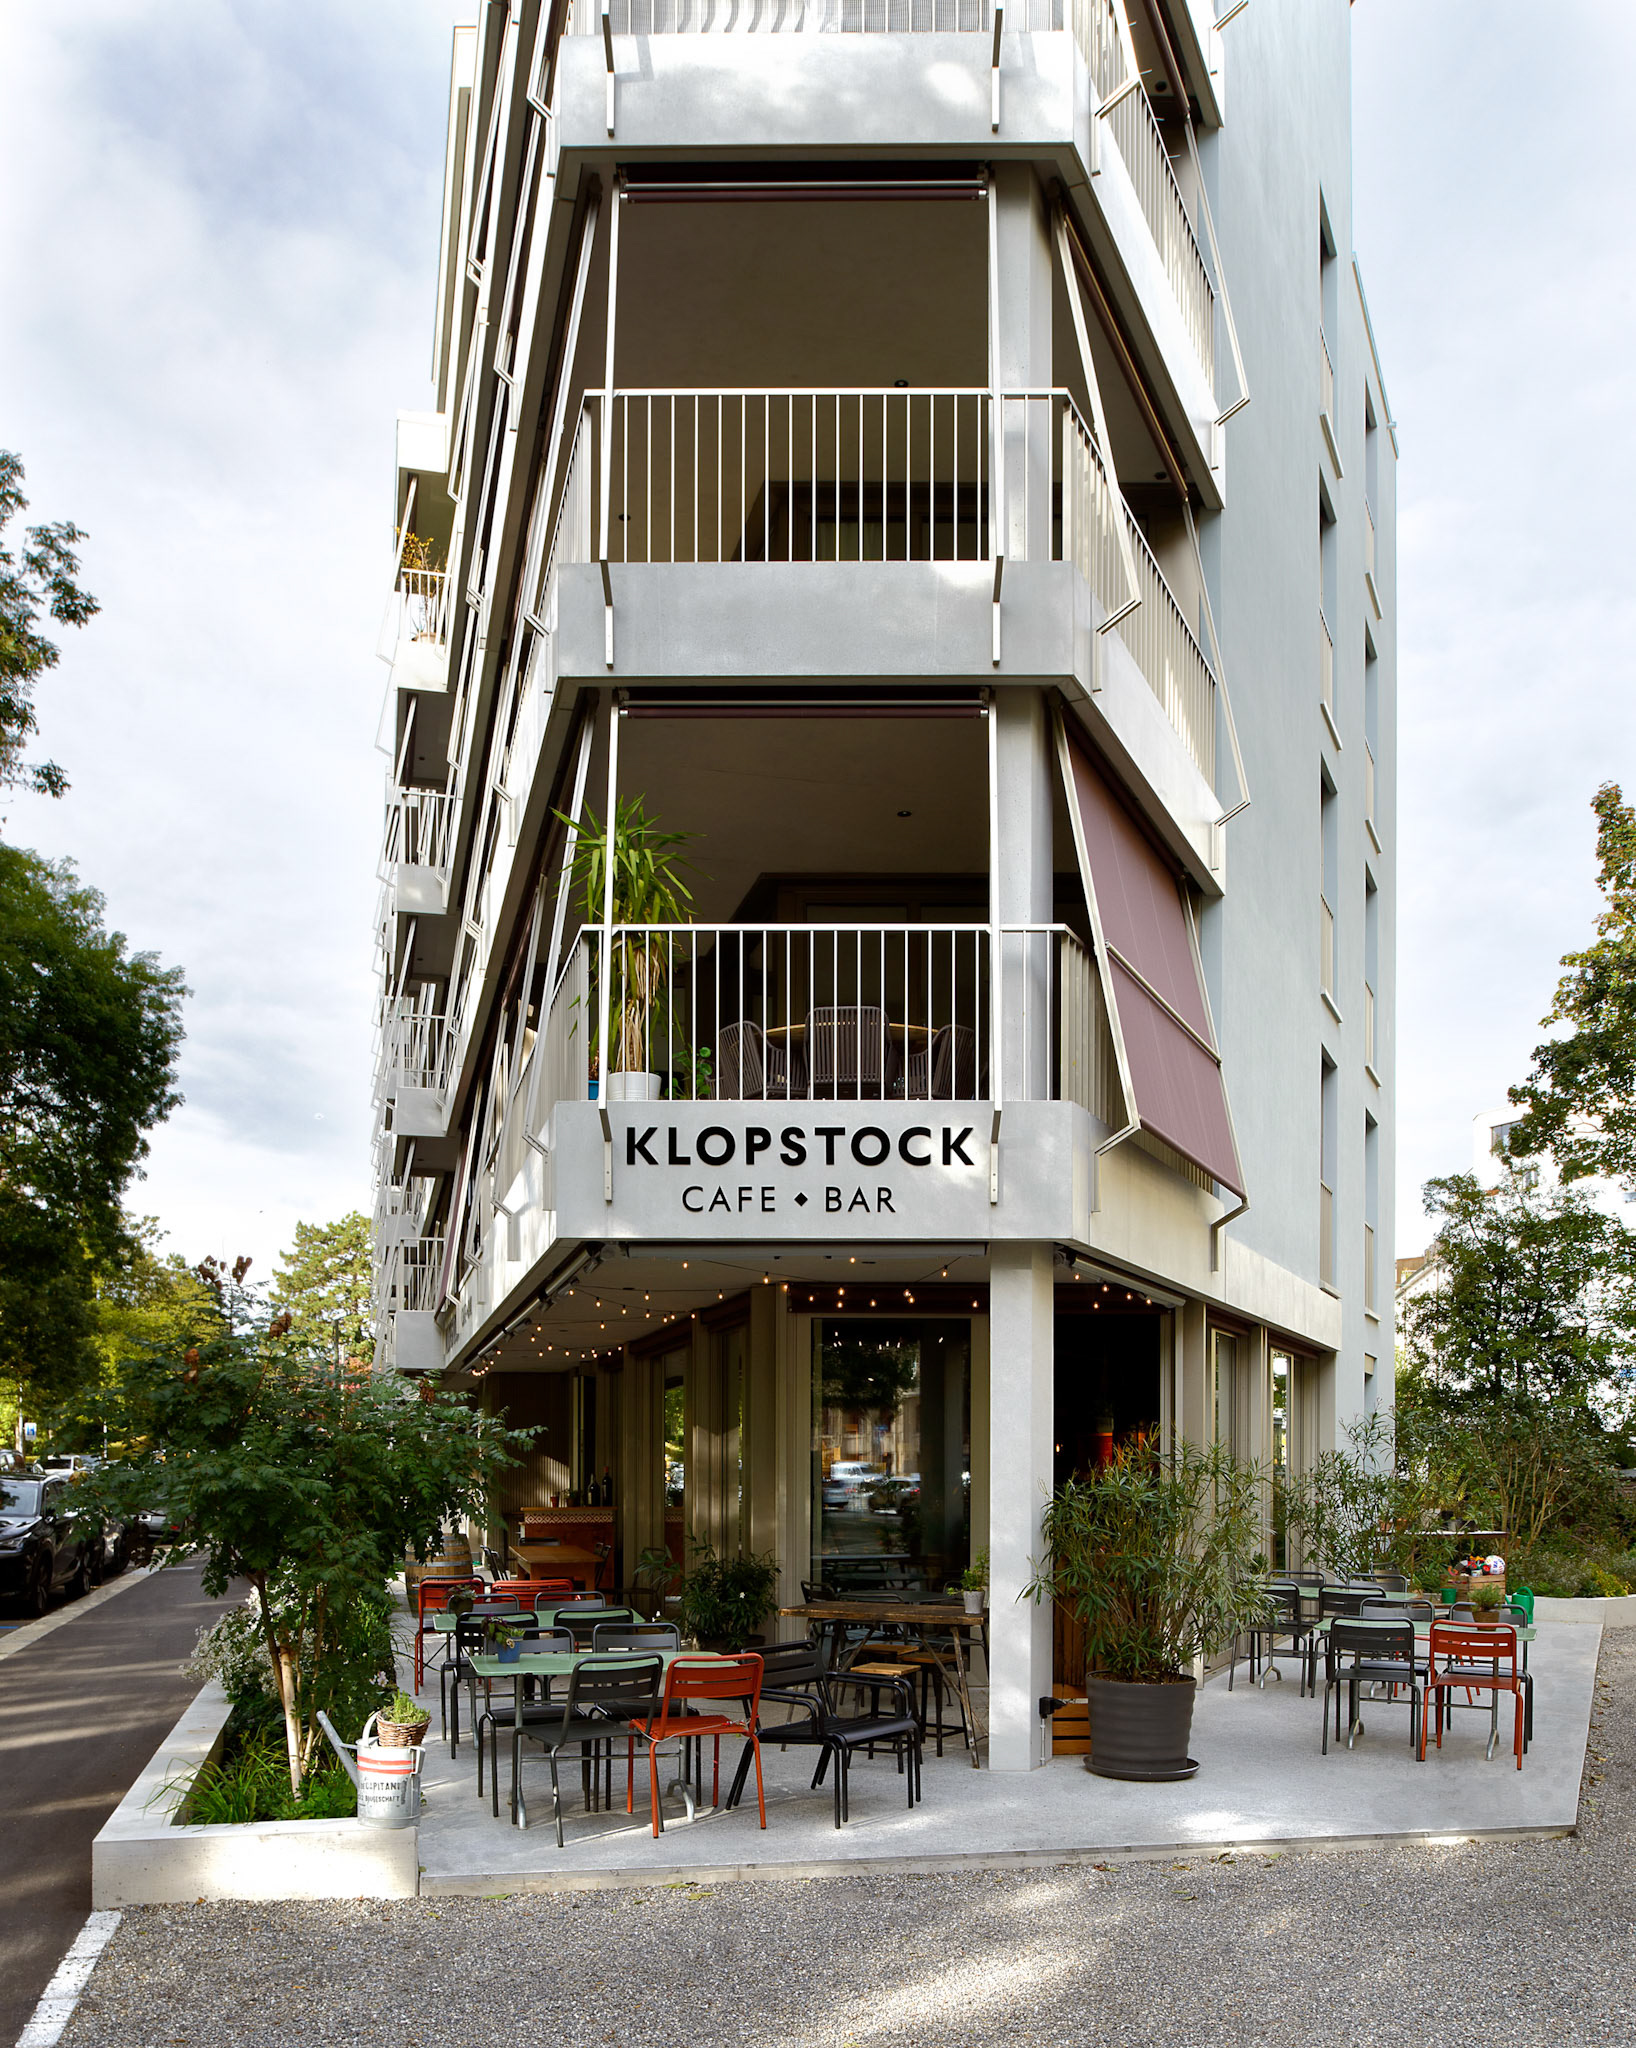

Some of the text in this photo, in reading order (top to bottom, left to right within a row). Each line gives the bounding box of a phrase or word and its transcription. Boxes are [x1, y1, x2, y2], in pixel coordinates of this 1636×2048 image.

[626, 1126, 975, 1167] KLOPSTOCK
[682, 1185, 896, 1213] CAFE BAR
